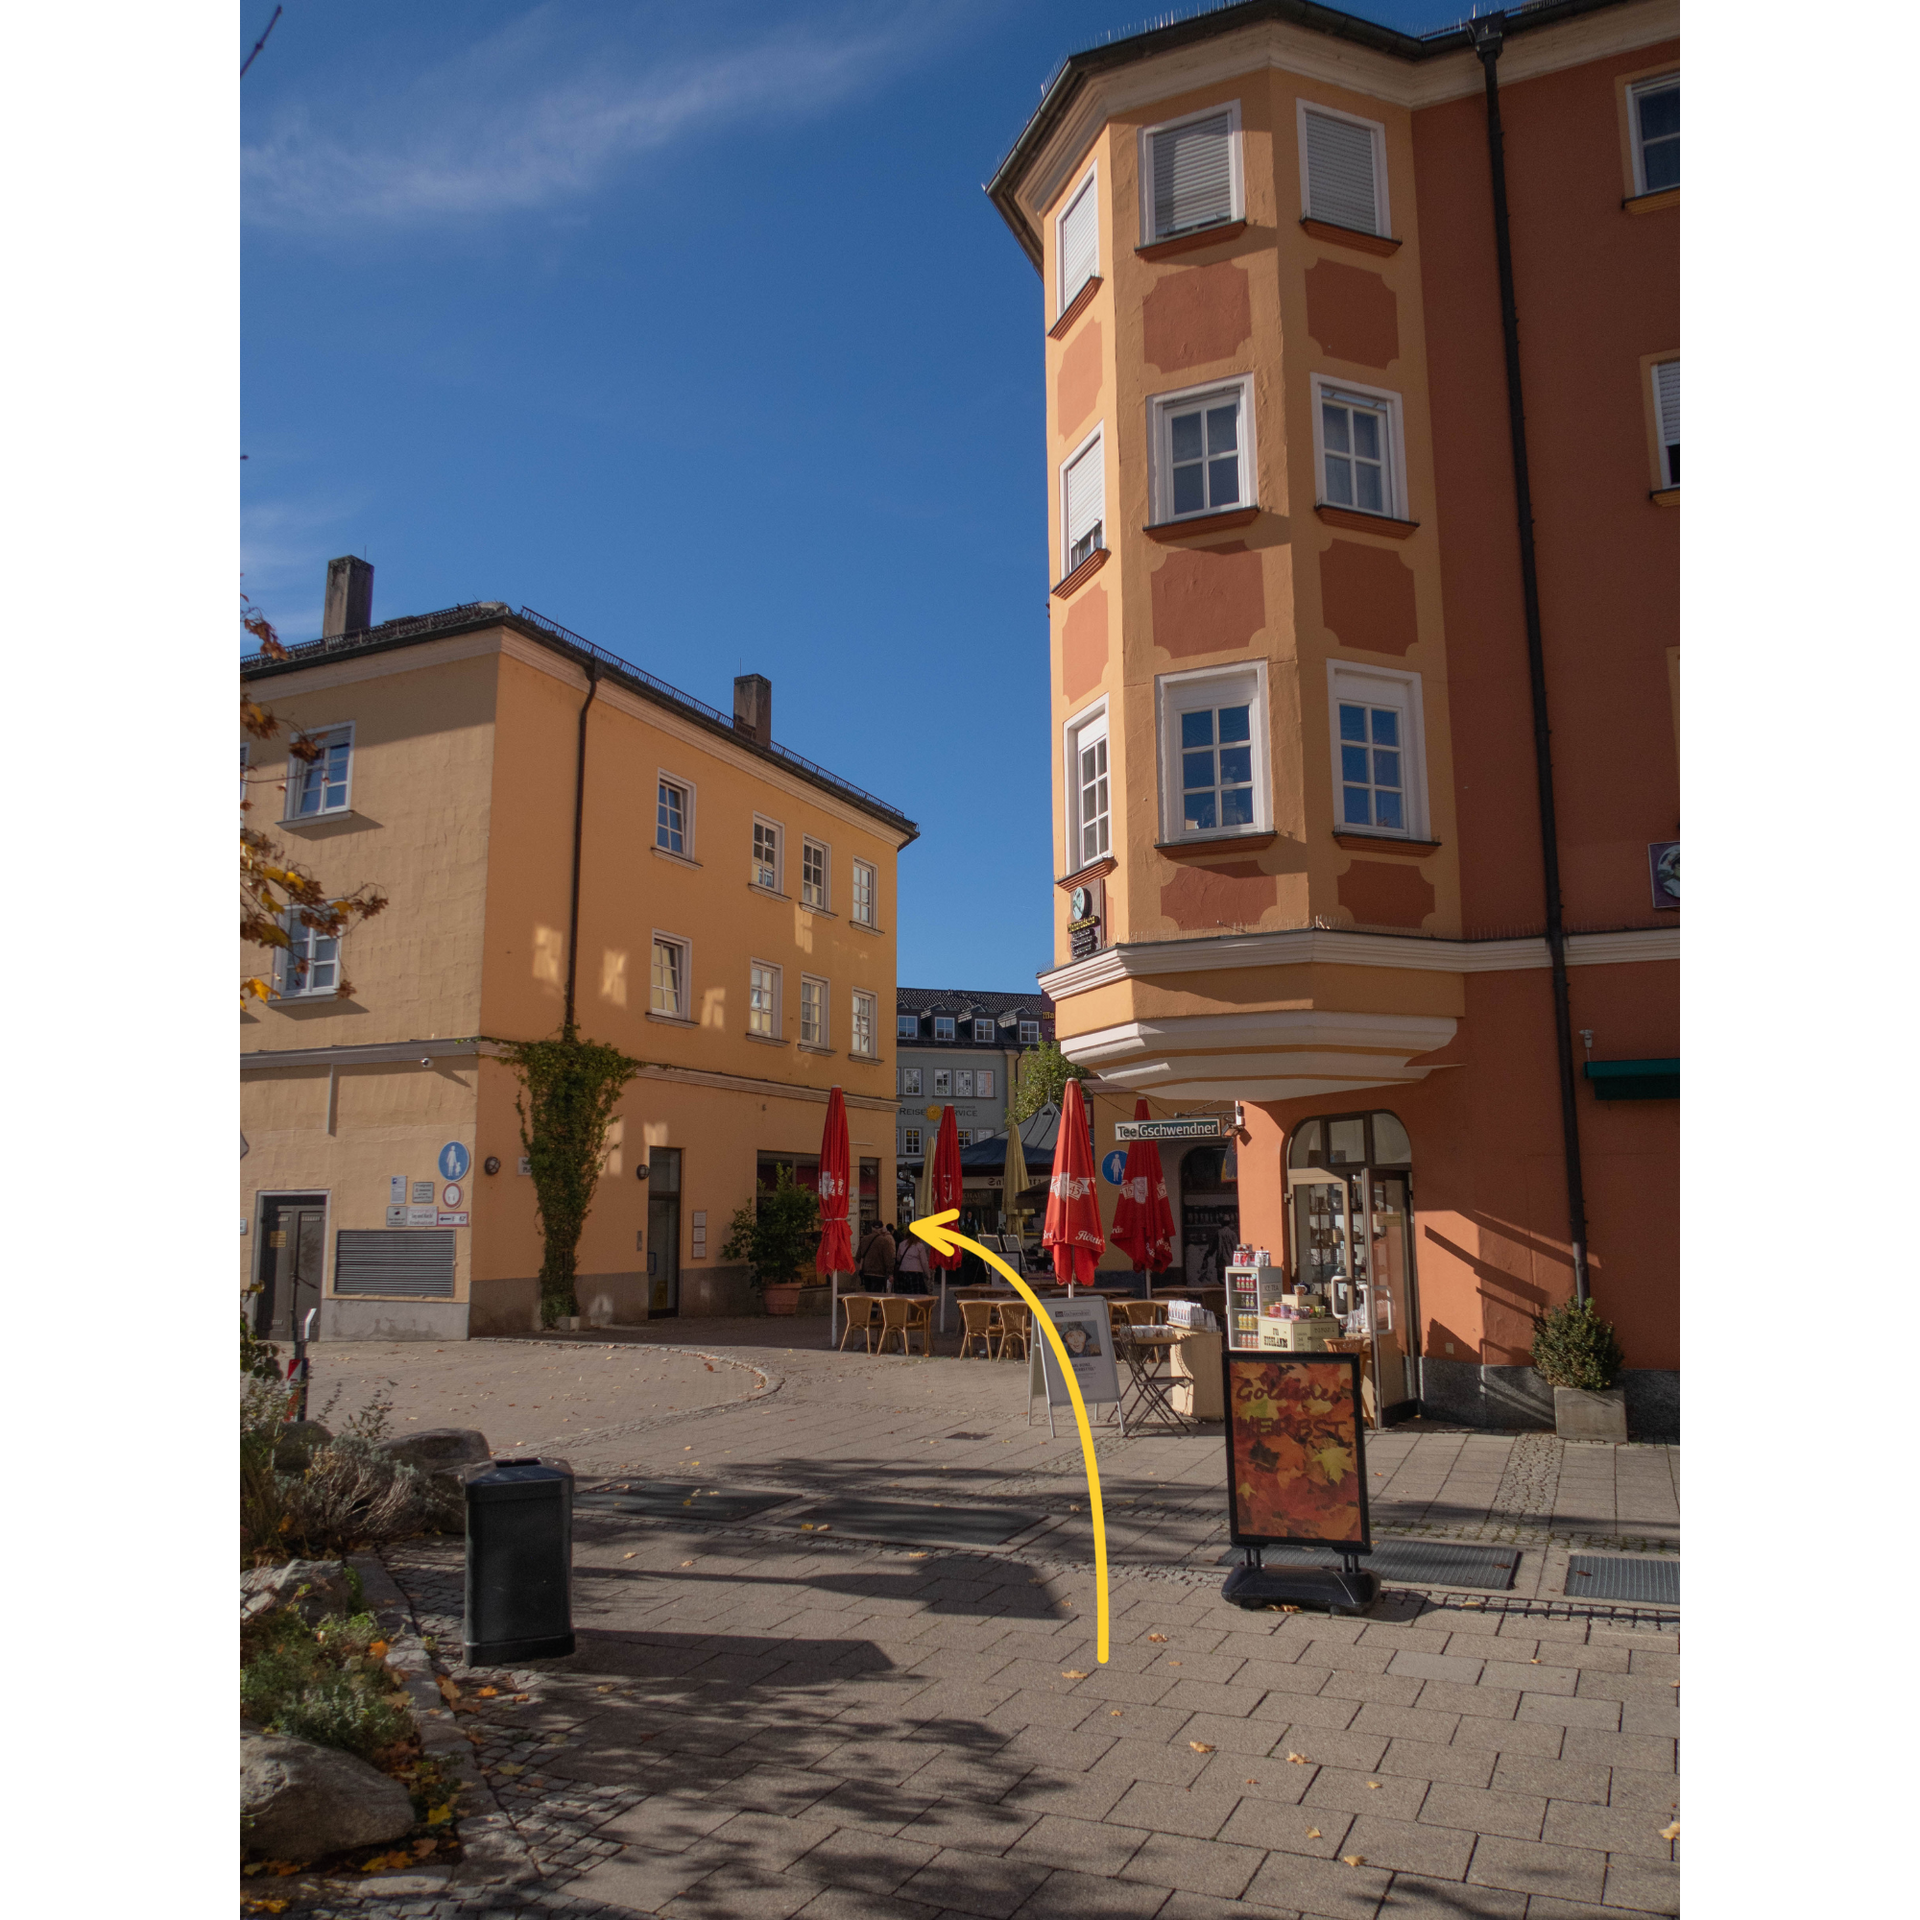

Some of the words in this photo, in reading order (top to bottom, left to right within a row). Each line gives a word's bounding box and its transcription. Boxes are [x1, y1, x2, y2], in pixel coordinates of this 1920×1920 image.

[899, 1107, 925, 1116] REISE
[1117, 1126, 1136, 1138] Tee
[1139, 1122, 1217, 1137] Gschwendner
[1236, 1379, 1341, 1404] Goldener
[1237, 1415, 1347, 1441] HERBST
